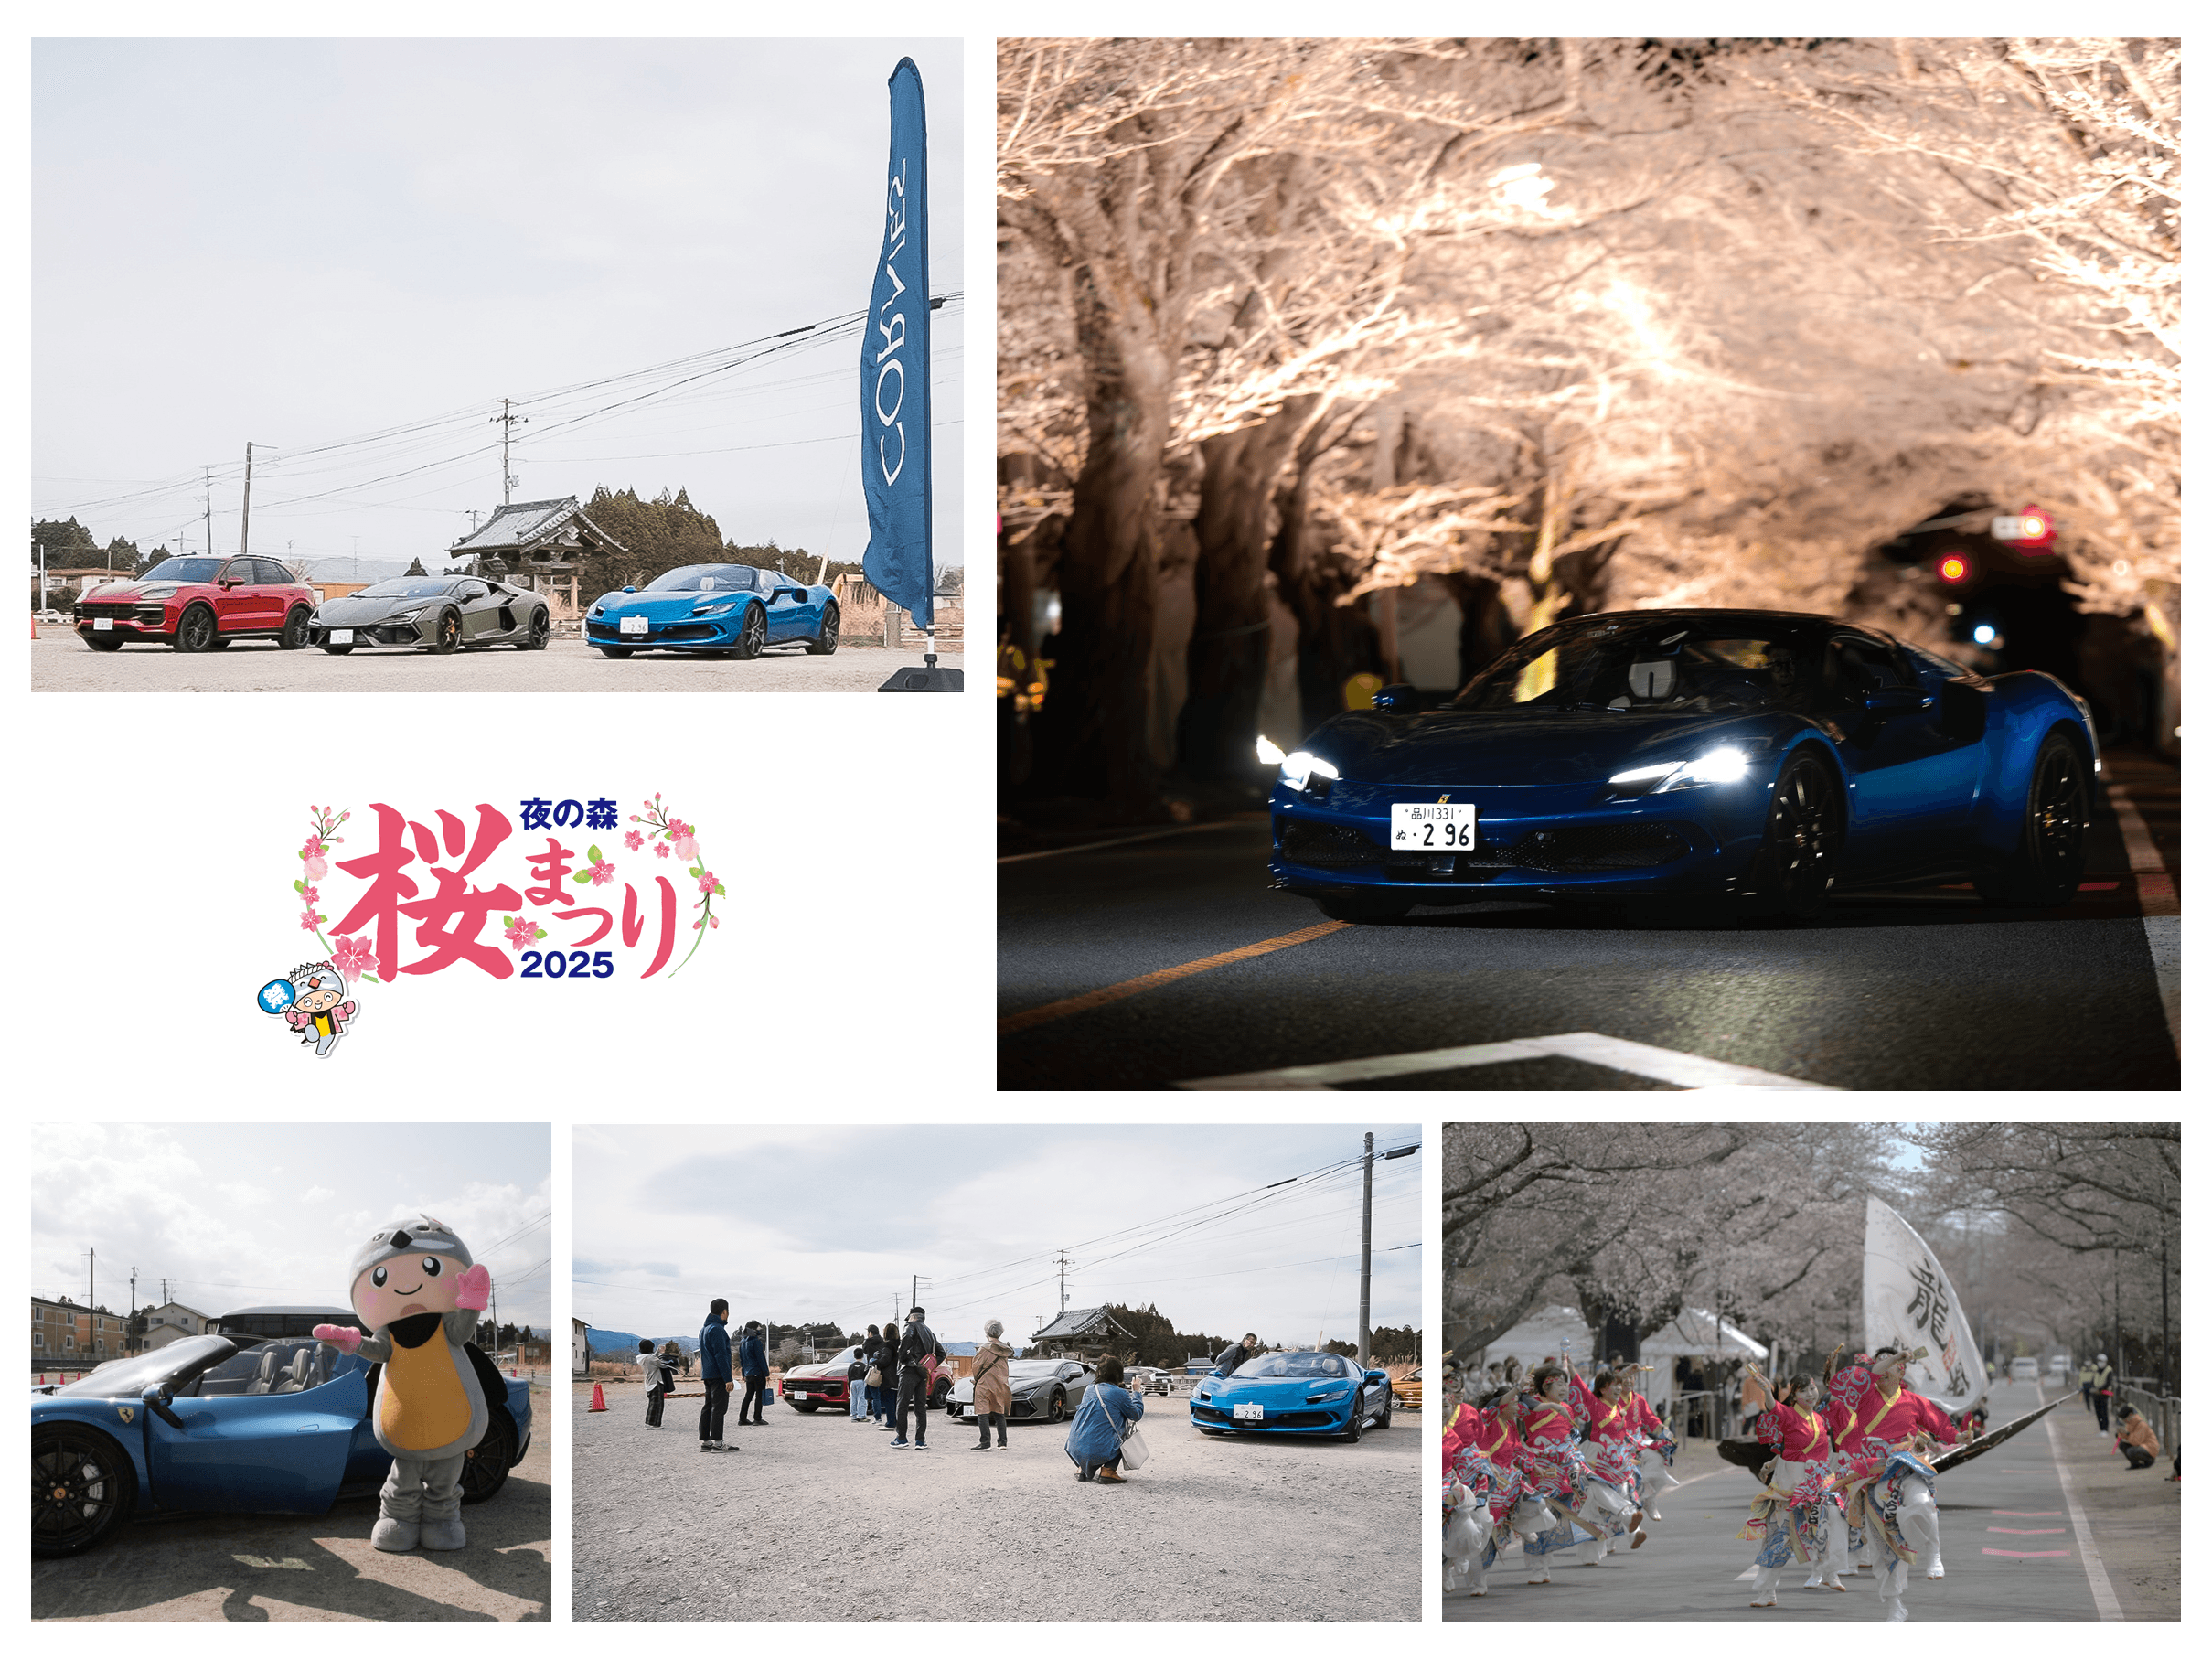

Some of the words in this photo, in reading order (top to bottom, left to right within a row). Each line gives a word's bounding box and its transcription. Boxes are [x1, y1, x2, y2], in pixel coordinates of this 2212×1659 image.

[519, 797, 619, 830] 夜の森
[520, 950, 614, 979] 2025
